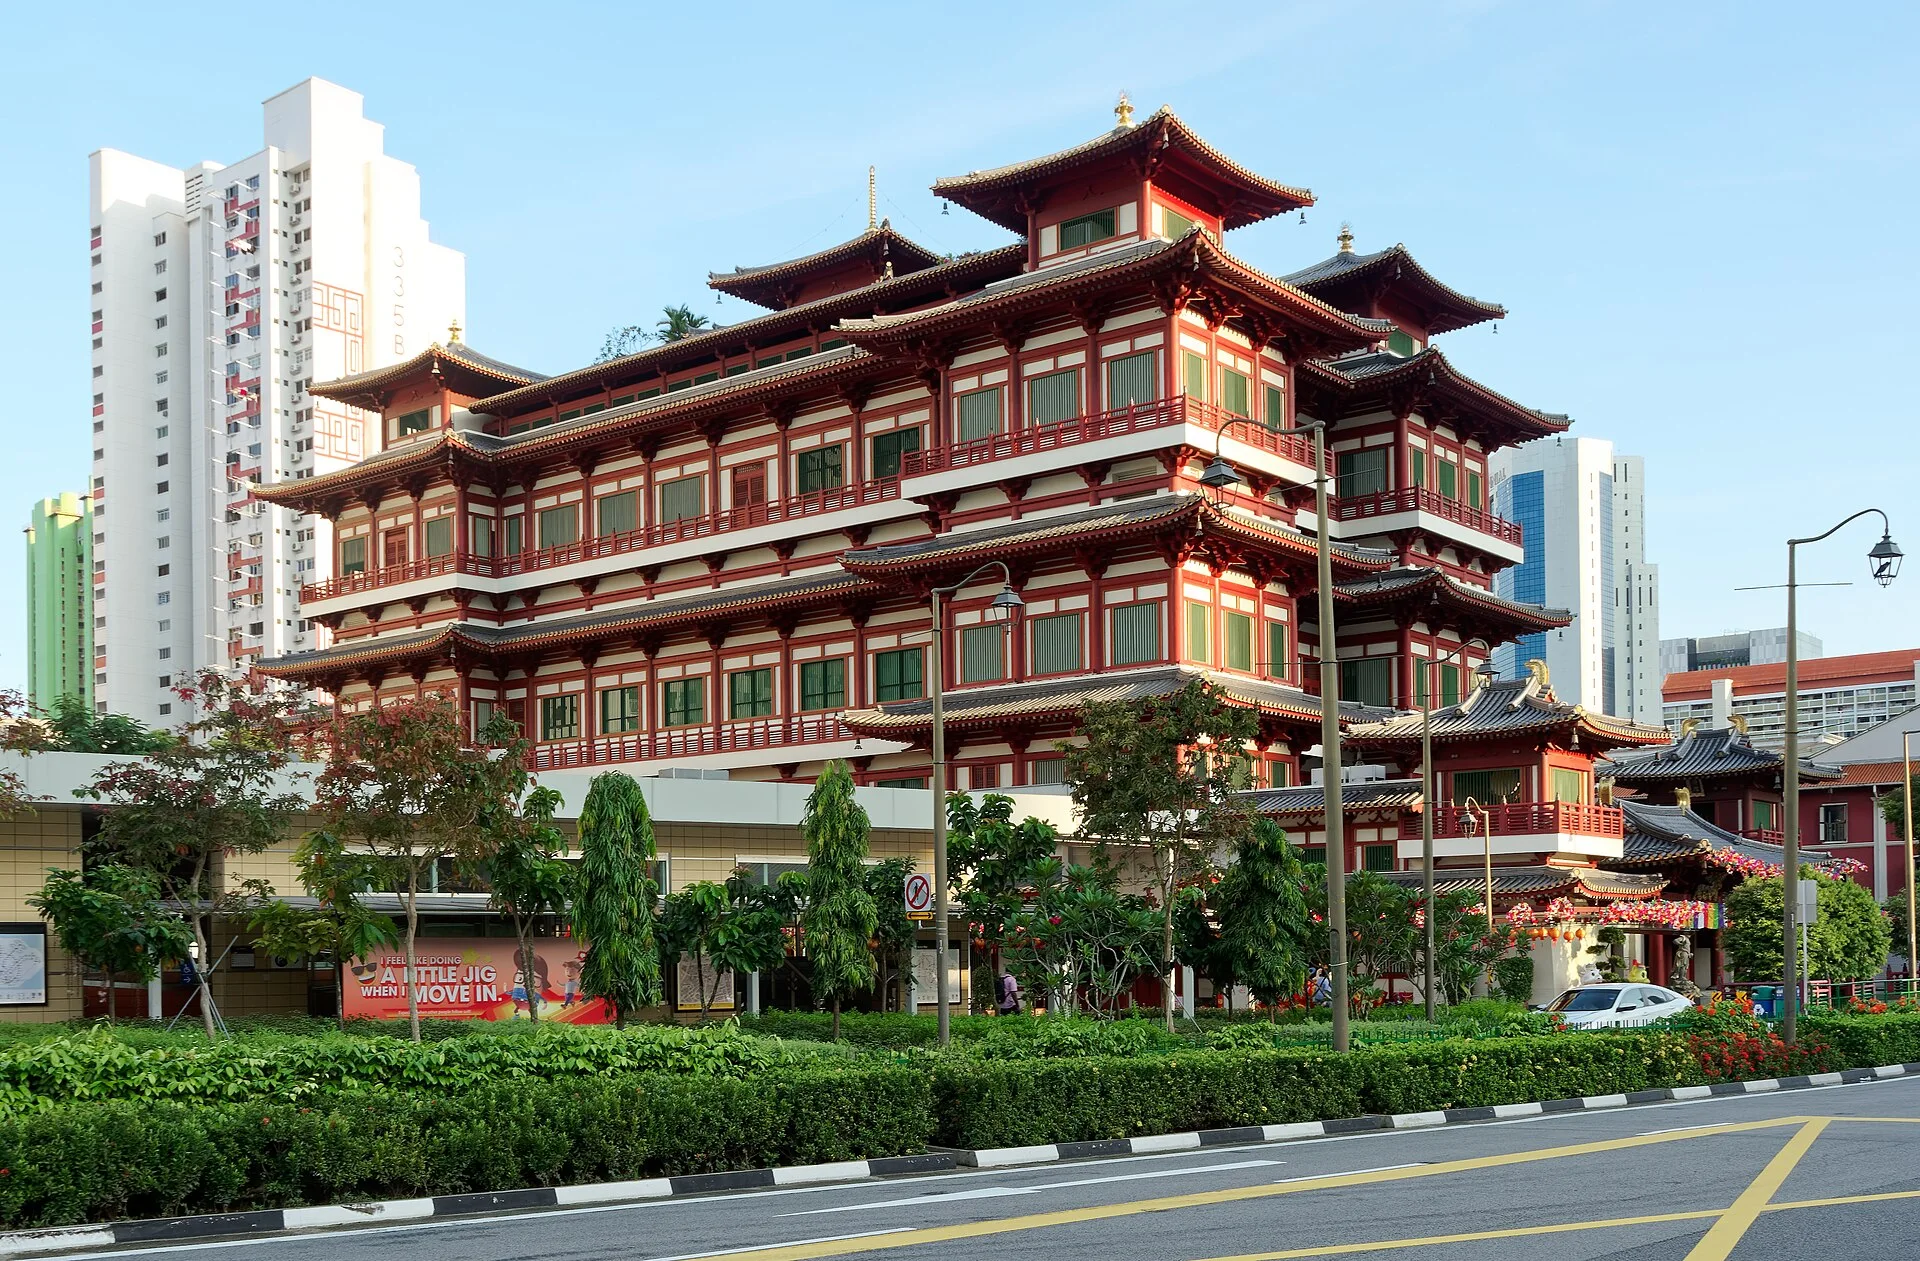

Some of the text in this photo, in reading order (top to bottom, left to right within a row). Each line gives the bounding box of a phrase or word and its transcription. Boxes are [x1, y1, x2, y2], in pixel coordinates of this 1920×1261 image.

[394, 246, 404, 355] 335B
[387, 957, 406, 965] FEEL
[411, 956, 428, 965] IKE
[430, 956, 462, 965] DOING
[380, 966, 397, 984] A
[462, 965, 497, 983] JIG
[361, 985, 503, 1003] WHEN I MOVE IN.
